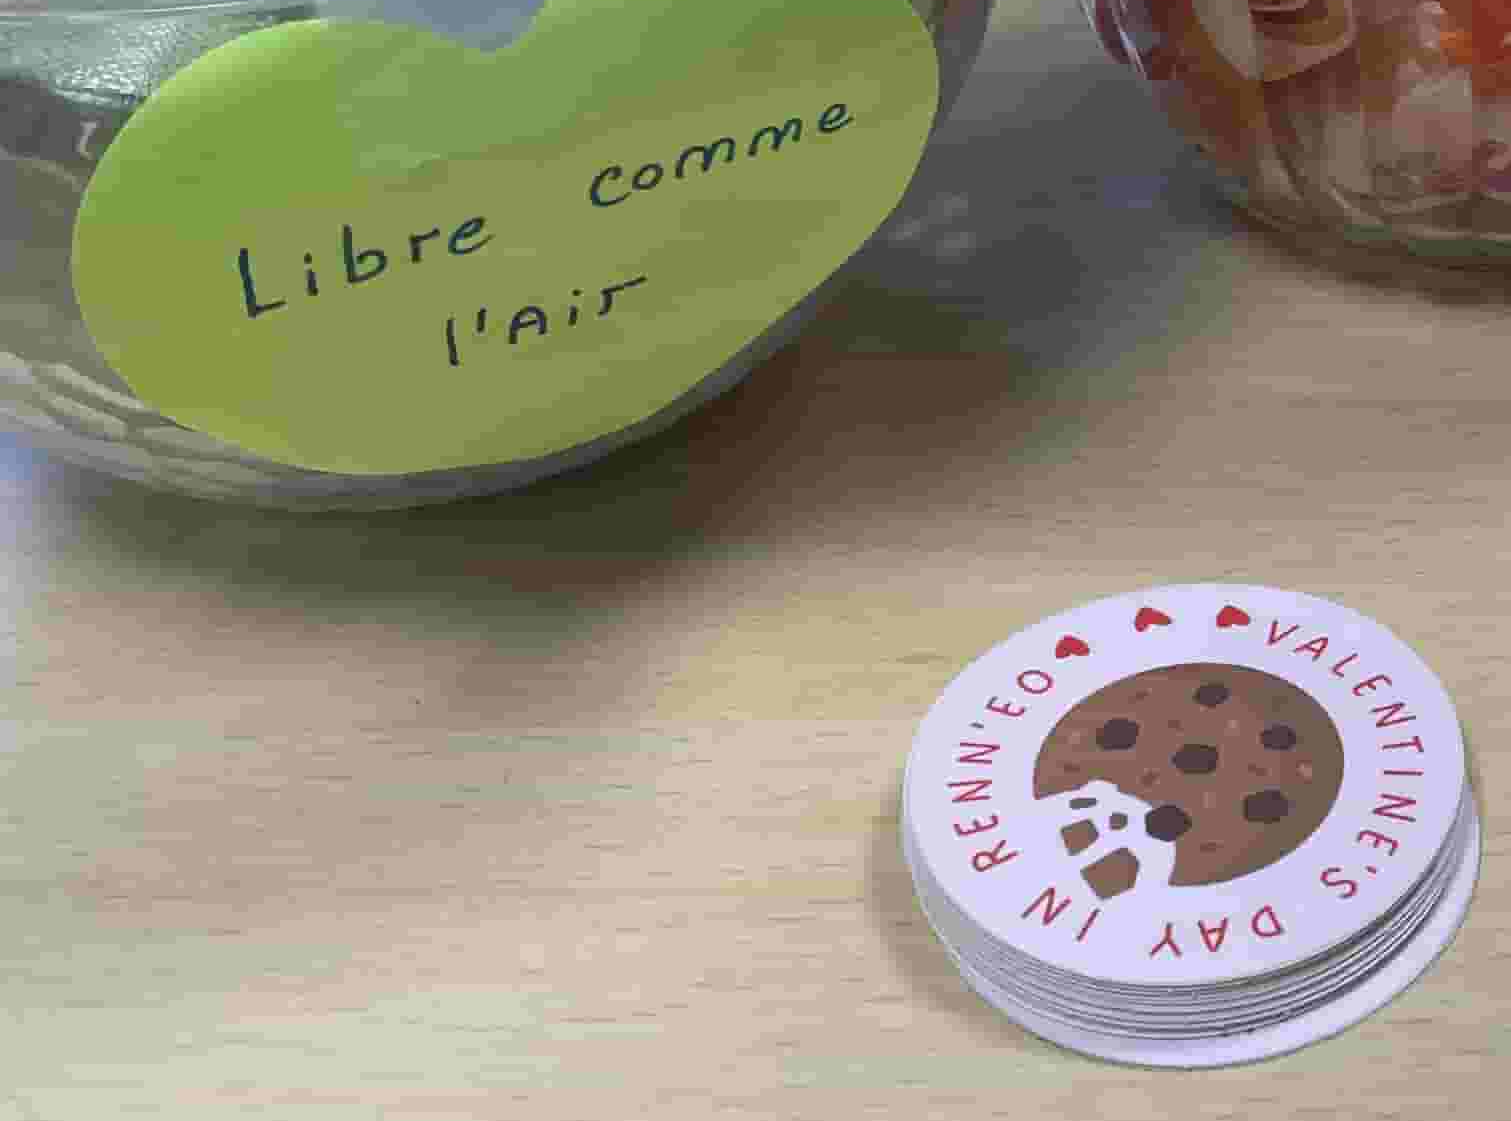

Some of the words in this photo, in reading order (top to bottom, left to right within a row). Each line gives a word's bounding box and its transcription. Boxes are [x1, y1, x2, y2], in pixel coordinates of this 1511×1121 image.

[238, 215, 496, 318] Libre
[946, 668, 1053, 873] RENN'EO
[1265, 619, 1424, 899] VALENTINE'S
[1020, 886, 1100, 942] IN
[1149, 904, 1284, 958] DAY
